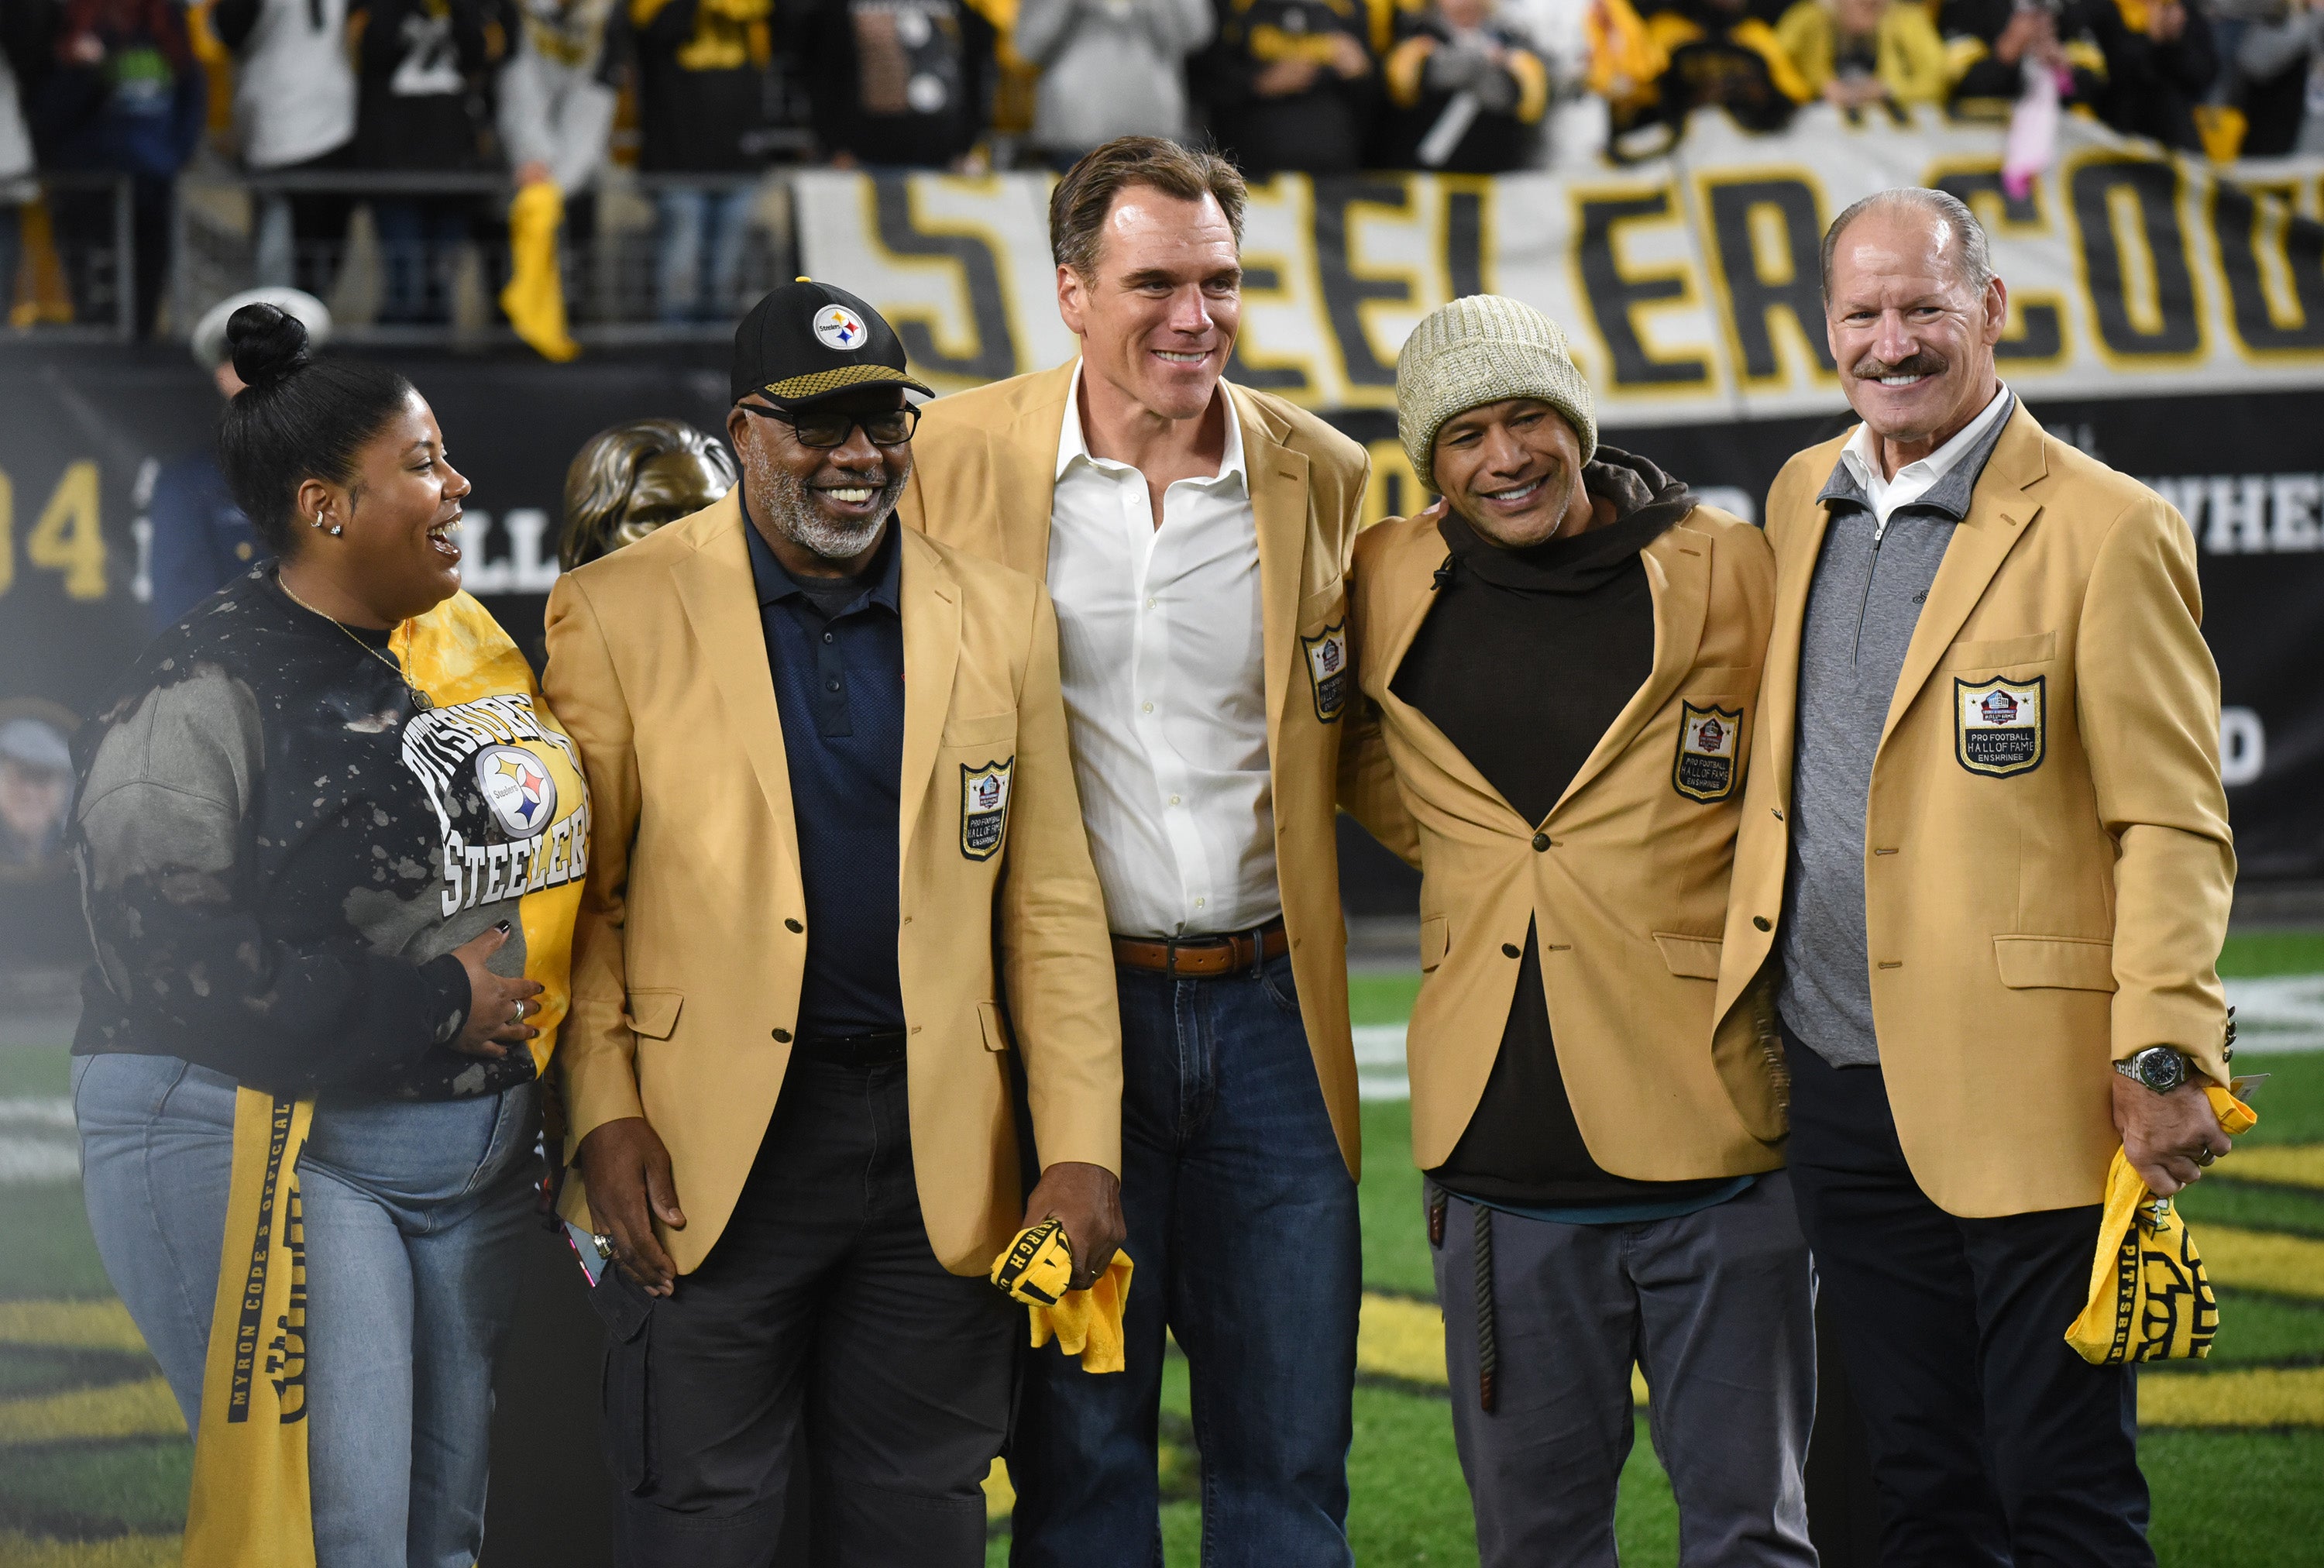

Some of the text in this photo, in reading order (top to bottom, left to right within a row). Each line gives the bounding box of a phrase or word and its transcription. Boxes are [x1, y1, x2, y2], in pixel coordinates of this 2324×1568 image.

[858, 164, 1851, 409] SEELER
[1990, 733, 2030, 741] FOOTBALL
[1968, 741, 2033, 752] HALL OF FAME
[1699, 759, 1725, 769] FOOTBALL
[1681, 766, 1728, 781] HALL OF FAME
[493, 784, 518, 799] Steelers
[968, 827, 983, 838] HALL
[441, 803, 590, 917] STEELER
[233, 1104, 290, 1406] MYRON COPE'S OFFICIAL
[2111, 1244, 2136, 1359] PITTSBUR
